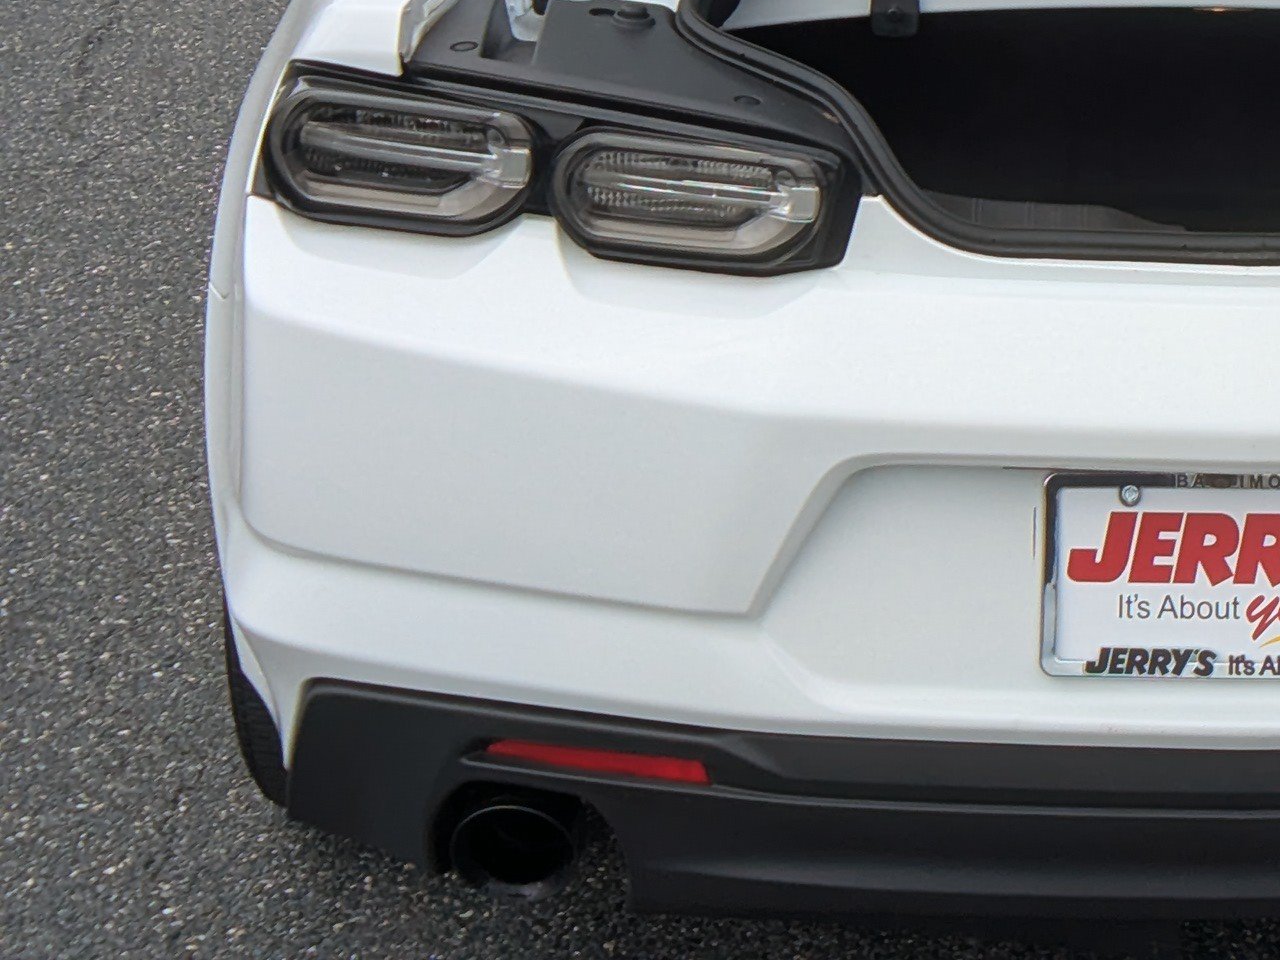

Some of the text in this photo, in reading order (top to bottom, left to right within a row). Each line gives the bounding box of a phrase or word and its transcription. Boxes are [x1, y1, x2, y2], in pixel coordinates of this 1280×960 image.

[1118, 594, 1150, 619] It's
[1157, 594, 1239, 620] About
[1085, 647, 1218, 677] JERRY'S
[1229, 654, 1258, 677] It's
